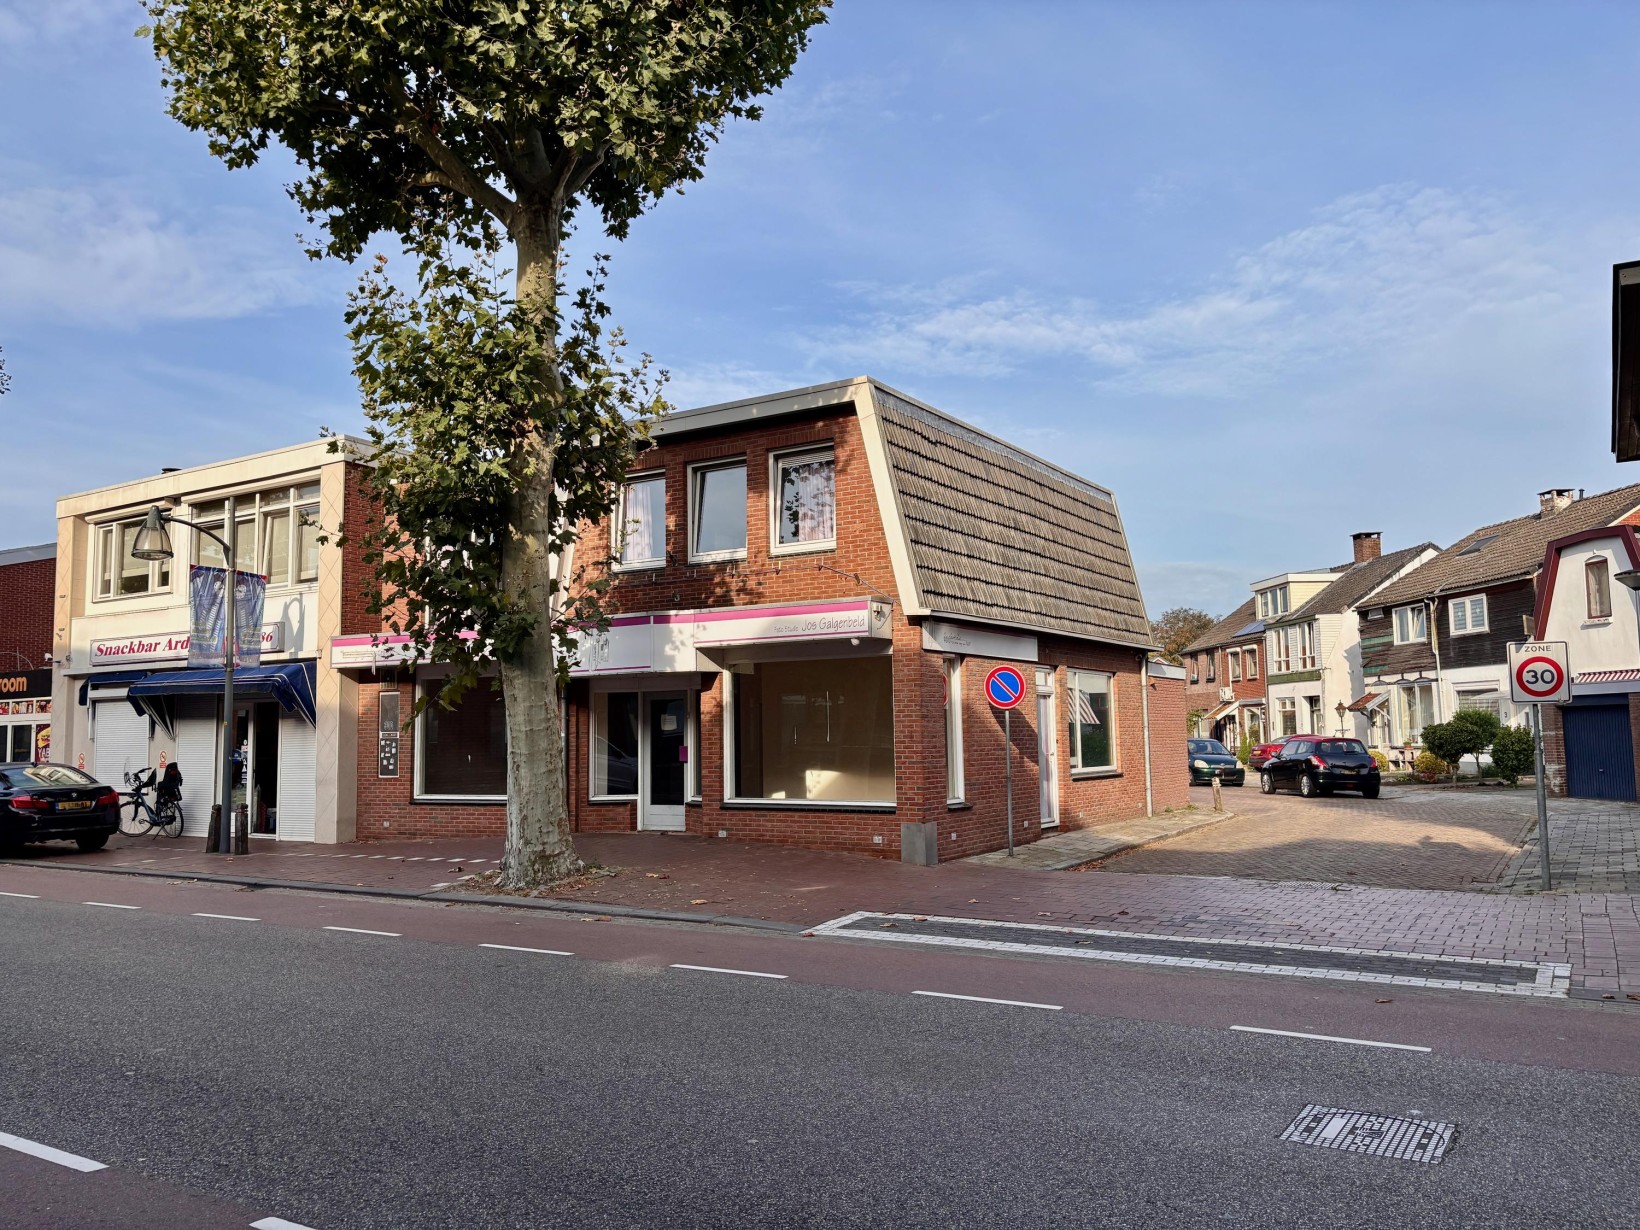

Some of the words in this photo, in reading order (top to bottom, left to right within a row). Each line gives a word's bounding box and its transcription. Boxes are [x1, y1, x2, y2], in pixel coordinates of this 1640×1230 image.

[801, 619, 817, 631] Jos
[94, 639, 161, 657] Snackbar
[162, 635, 190, 652] Ard
[1524, 645, 1552, 653] ZONE
[1525, 669, 1555, 685] 30
